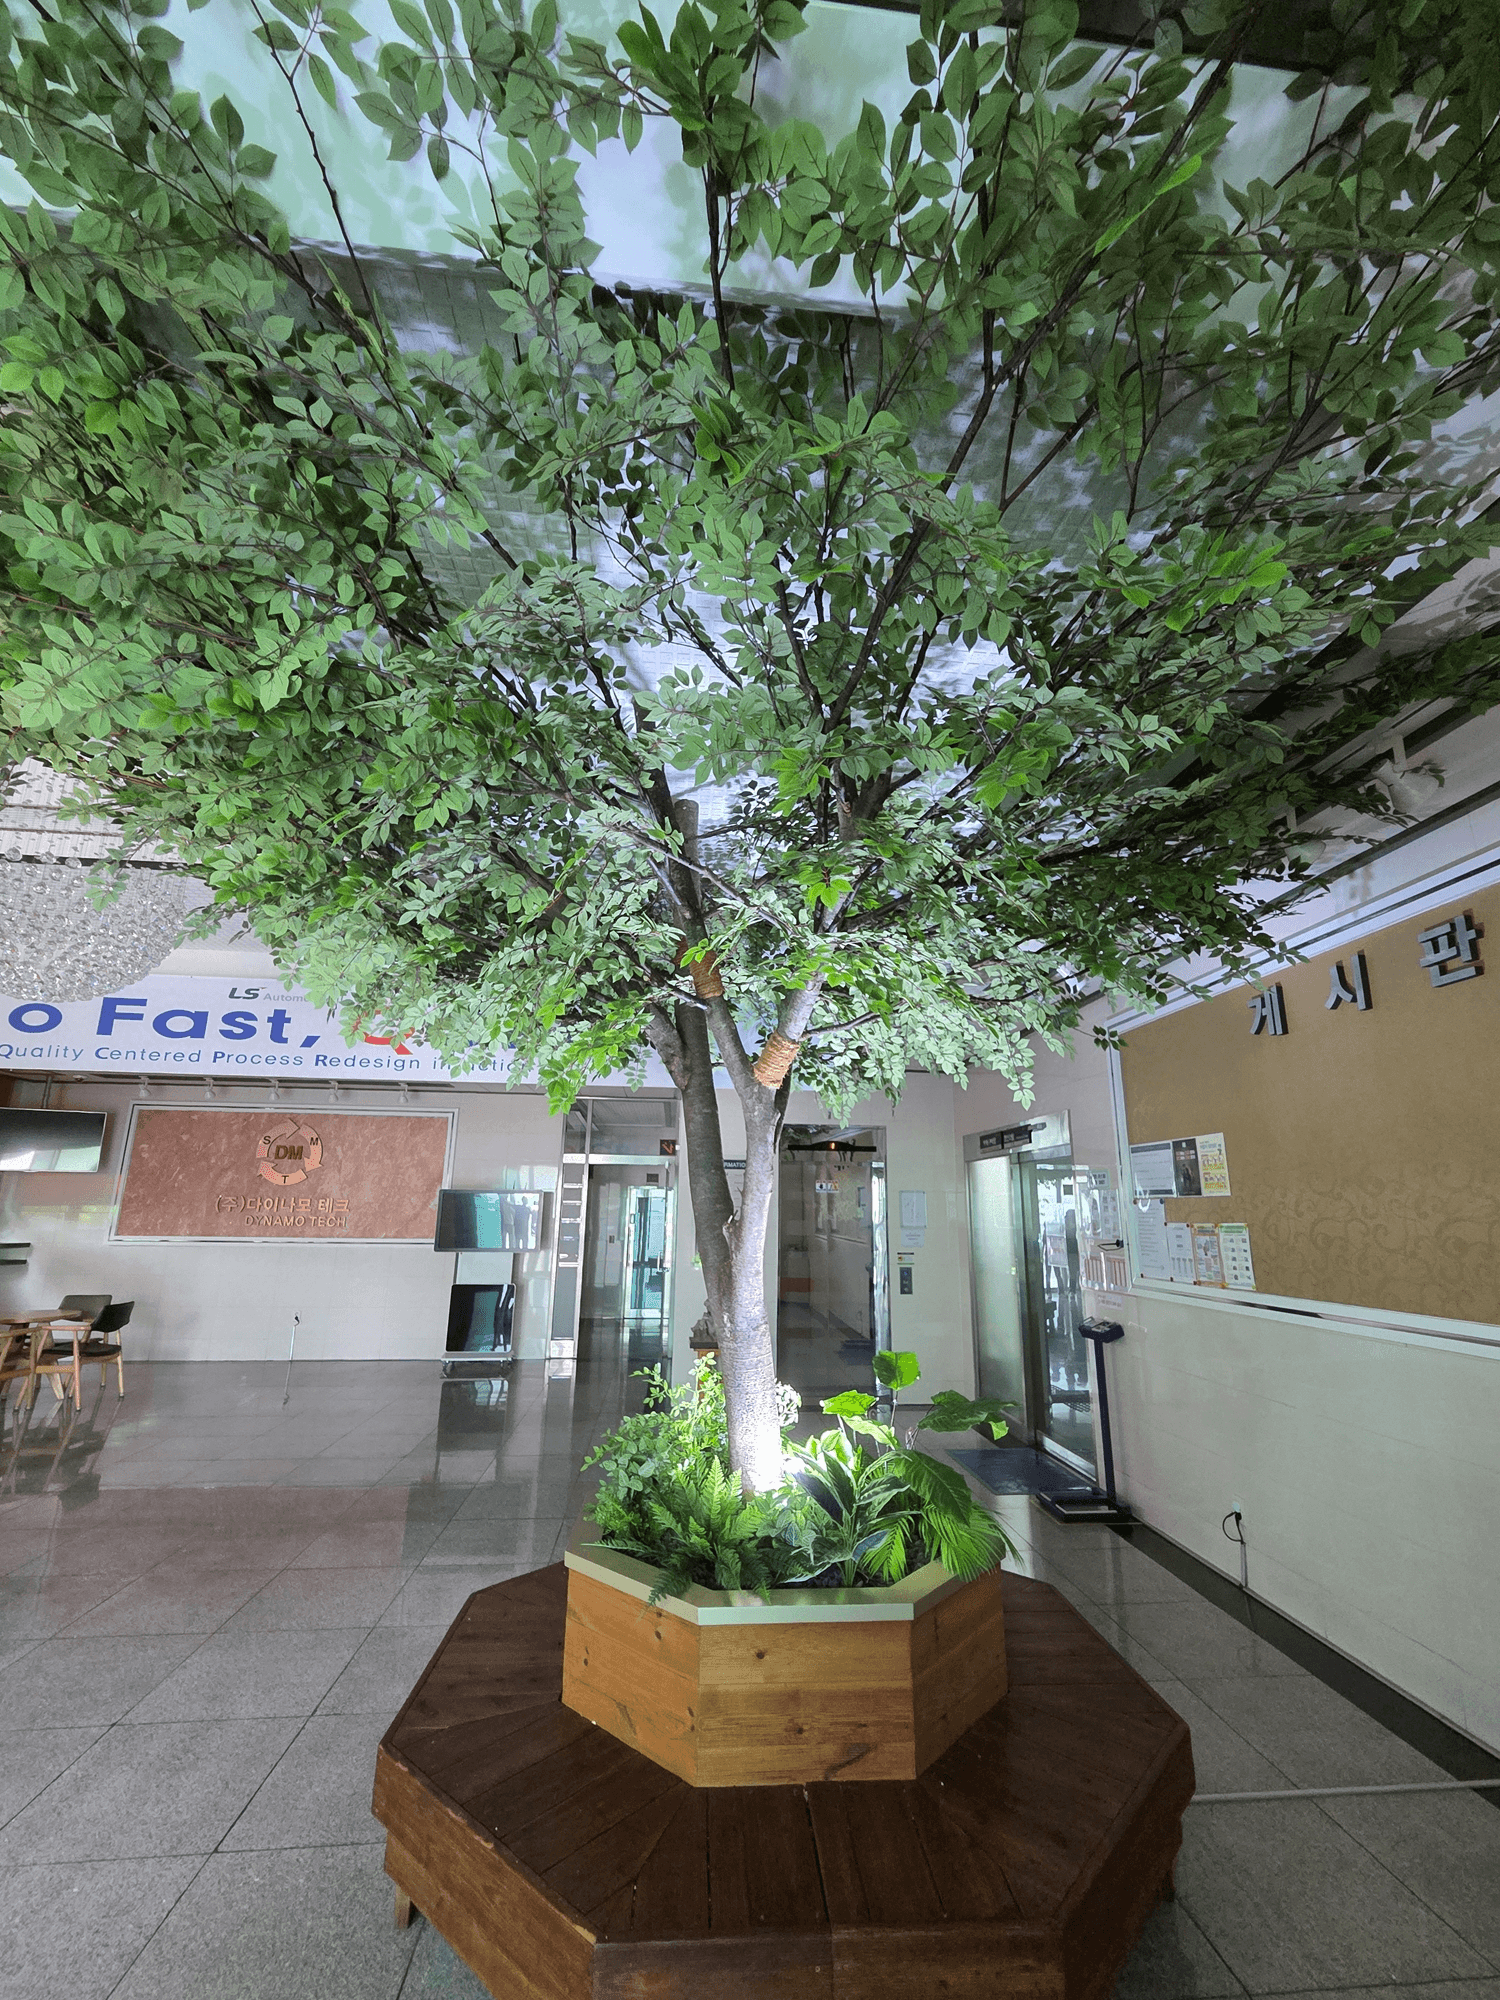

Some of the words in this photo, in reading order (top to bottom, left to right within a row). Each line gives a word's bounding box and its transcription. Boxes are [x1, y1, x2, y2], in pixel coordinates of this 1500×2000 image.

[228, 987, 260, 1000] LS
[96, 996, 320, 1048] Fast,
[0, 1044, 84, 1061] Quality
[95, 1047, 201, 1063] Centered
[212, 1051, 304, 1066] Process
[314, 1054, 420, 1071] Redesign
[274, 1145, 304, 1160] DM
[318, 1197, 350, 1213] 테크
[245, 1215, 306, 1227] DYNAMO
[309, 1215, 347, 1227] TECH
